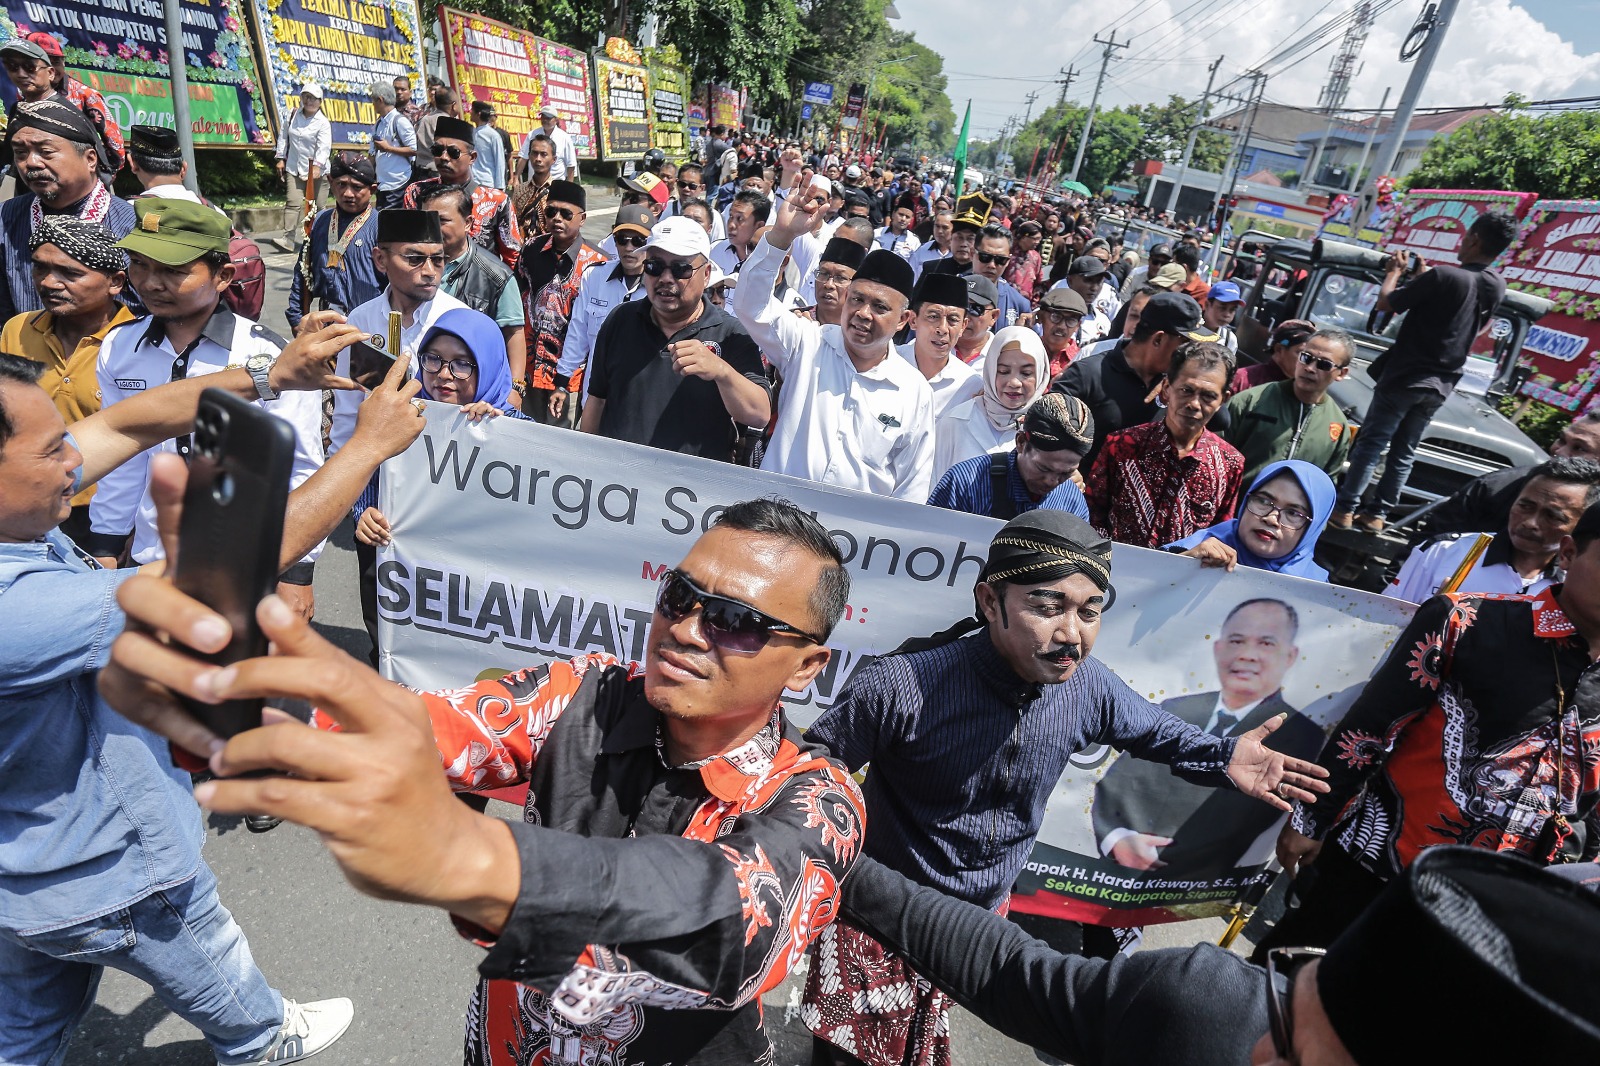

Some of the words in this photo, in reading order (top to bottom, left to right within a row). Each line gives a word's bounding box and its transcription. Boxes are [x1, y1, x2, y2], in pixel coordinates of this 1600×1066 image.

[24, 1, 82, 30] UNTUK
[82, 12, 156, 43] KABUPATEN
[157, 27, 203, 50] SMAN
[328, 16, 365, 34] KEPADA
[350, 1, 387, 28] KASIH
[290, 45, 309, 60] ATAS
[309, 48, 344, 67] DEDIKASI
[343, 54, 358, 69] DAN
[809, 82, 831, 93] ATM
[192, 116, 242, 141] atering
[423, 434, 639, 530] Warga
[1045, 878, 1098, 897] Sekda
[1099, 888, 1182, 904] Kabupaten
[1185, 890, 1237, 900] Sleman
[1072, 867, 1089, 880] H.
[1092, 871, 1144, 889] Harda
[1145, 879, 1210, 891] Kiswaya,
